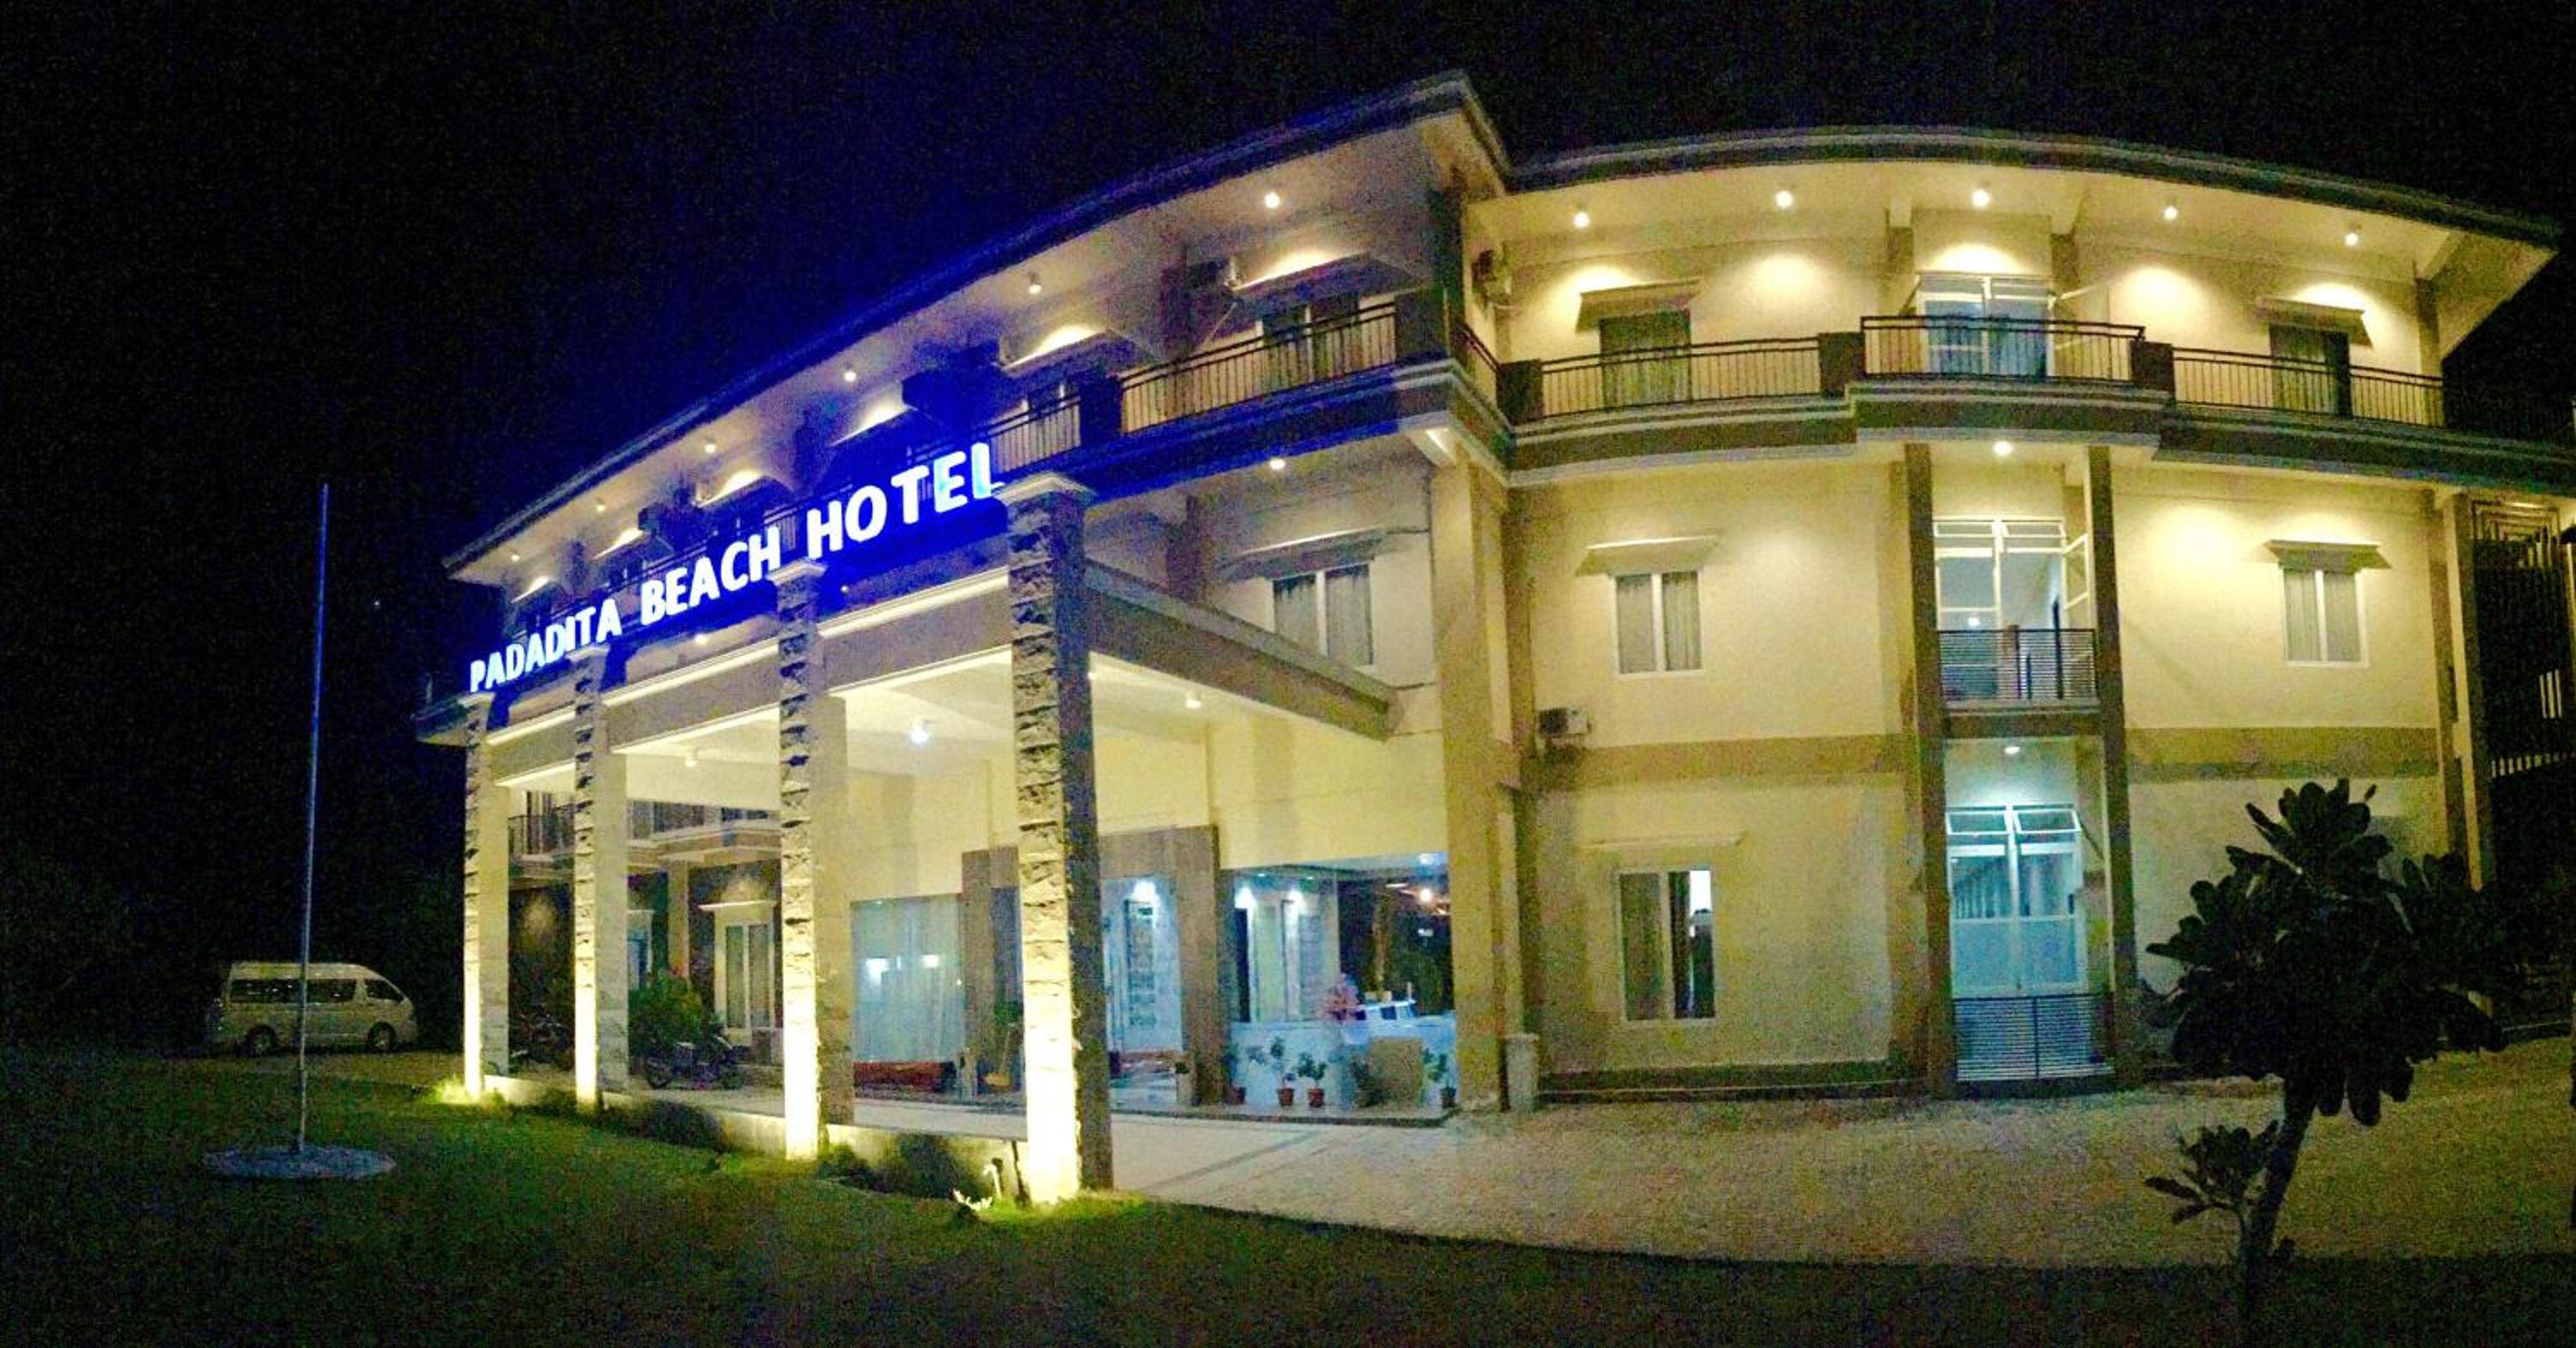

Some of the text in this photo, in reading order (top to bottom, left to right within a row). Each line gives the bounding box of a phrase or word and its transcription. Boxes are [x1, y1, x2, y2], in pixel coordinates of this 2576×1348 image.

[470, 442, 1004, 692] PADADITA BEACH HOTEL
